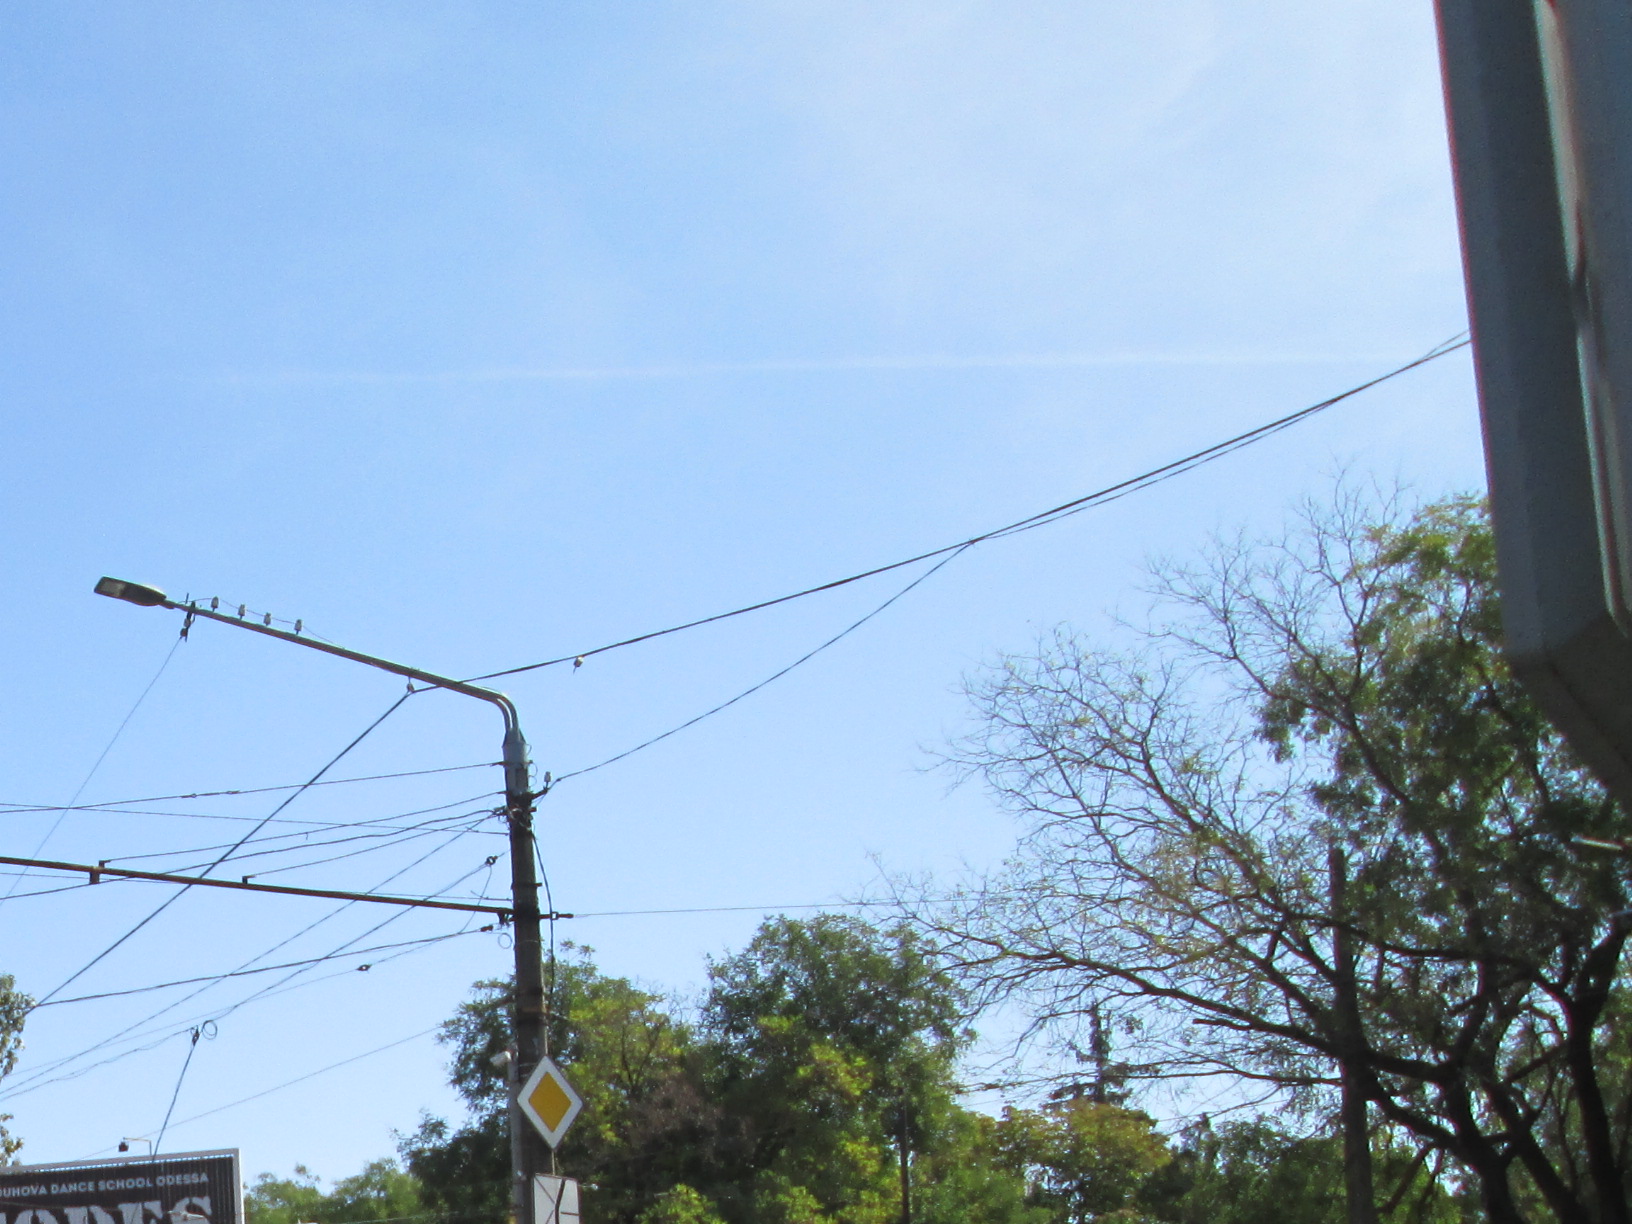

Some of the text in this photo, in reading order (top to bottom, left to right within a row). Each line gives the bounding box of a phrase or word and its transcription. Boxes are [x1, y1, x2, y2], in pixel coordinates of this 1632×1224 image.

[50, 1182, 96, 1195] DANCE
[98, 1177, 152, 1191] SCHOOL
[156, 1172, 209, 1186] ODESSA
